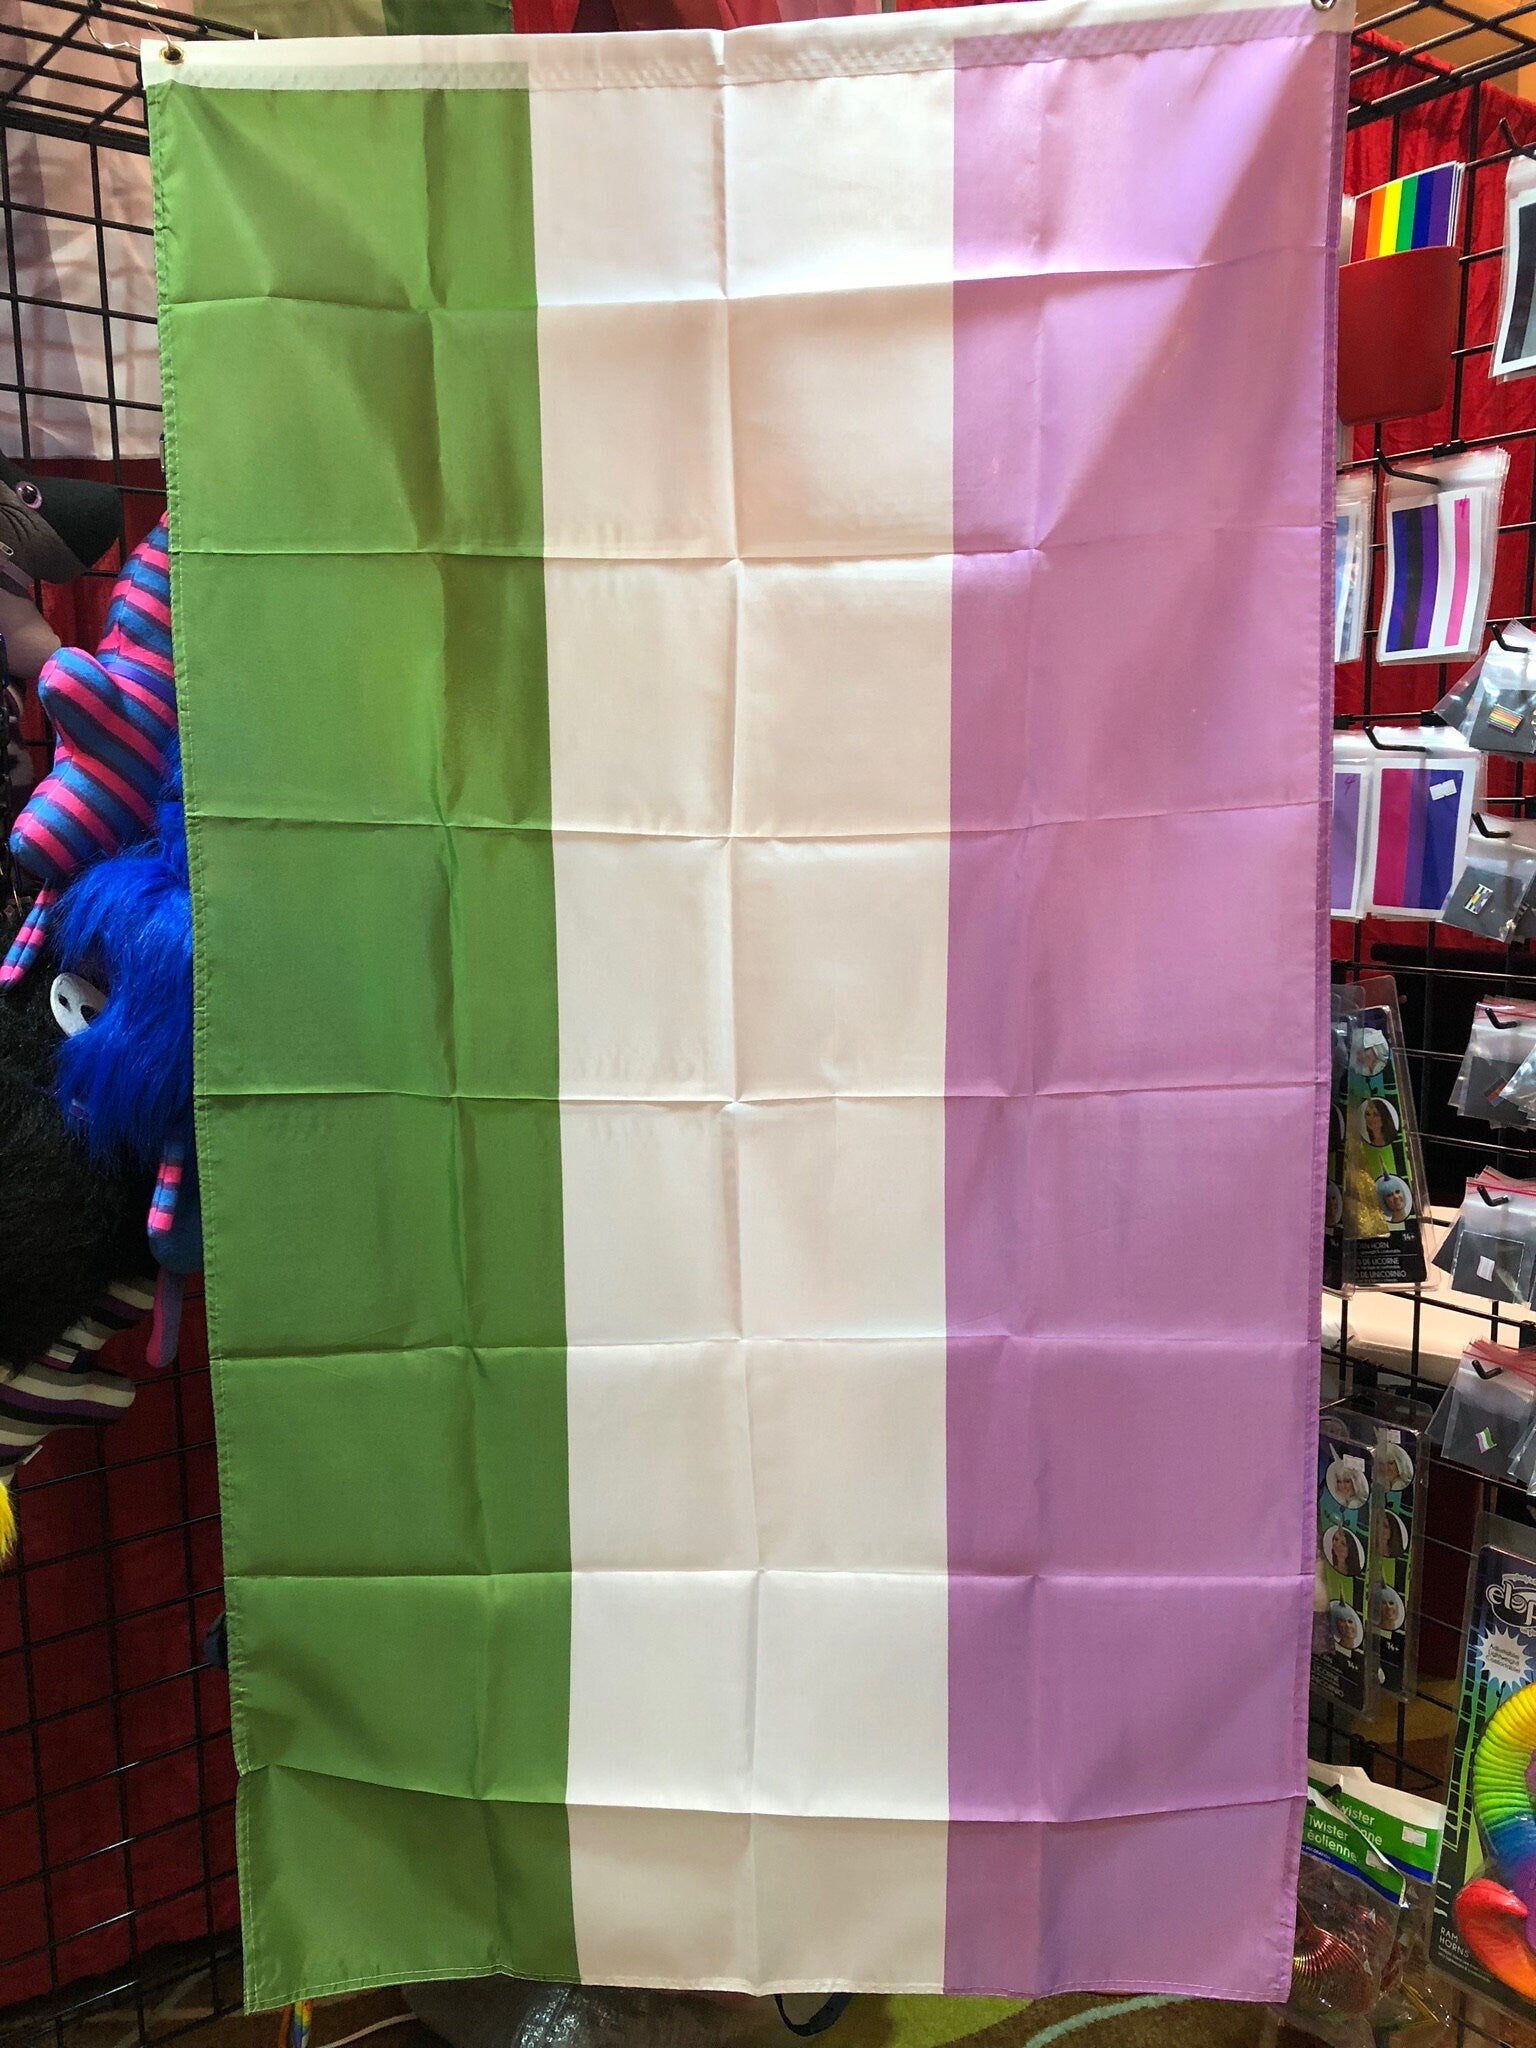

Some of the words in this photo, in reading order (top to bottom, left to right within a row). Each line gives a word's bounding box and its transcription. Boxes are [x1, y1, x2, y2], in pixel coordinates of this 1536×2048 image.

[1308, 1814, 1349, 1841] Twister
[1307, 1829, 1358, 1862] éolienne
[1439, 1935, 1469, 1958] HORNS
[1440, 1926, 1458, 1943] RAM
